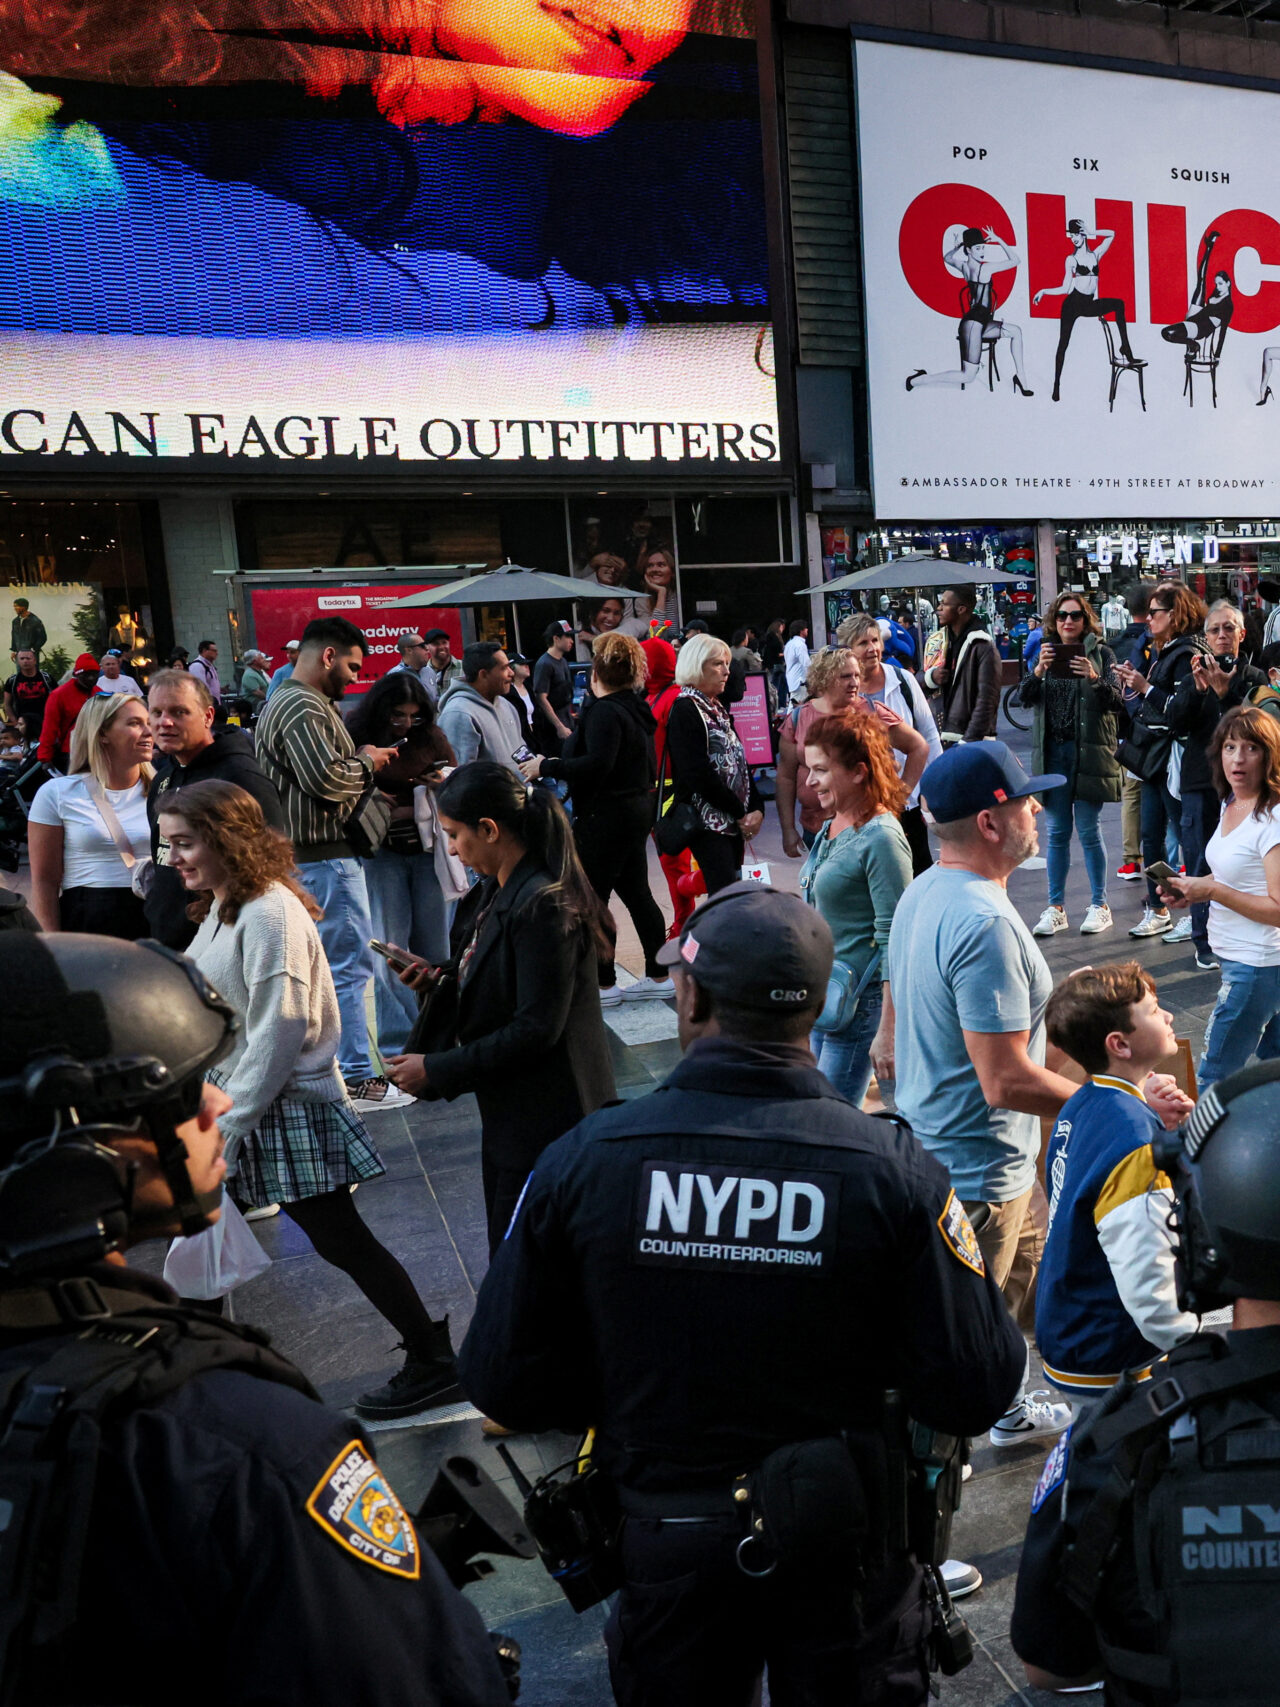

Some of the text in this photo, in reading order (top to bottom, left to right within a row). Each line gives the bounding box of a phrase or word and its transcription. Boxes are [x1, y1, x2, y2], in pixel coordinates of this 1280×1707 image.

[953, 146, 988, 160] POP
[1073, 157, 1099, 172] SIX
[1171, 168, 1230, 184] SQUISH
[1, 410, 778, 461] CAN EAGLE OUTFITTERS
[912, 477, 1008, 487] AMBASSADOR
[1016, 478, 1071, 487] THEATRE
[1089, 478, 1120, 488] 49TH
[1128, 479, 1171, 488] STREET
[1178, 479, 1191, 488] AT
[1198, 479, 1265, 488] BROADWAY
[1096, 534, 1220, 566] GRAND
[323, 598, 357, 607] todaytix
[645, 1170, 826, 1243] NYPD
[639, 1238, 823, 1267] COUNTERTERRORISM
